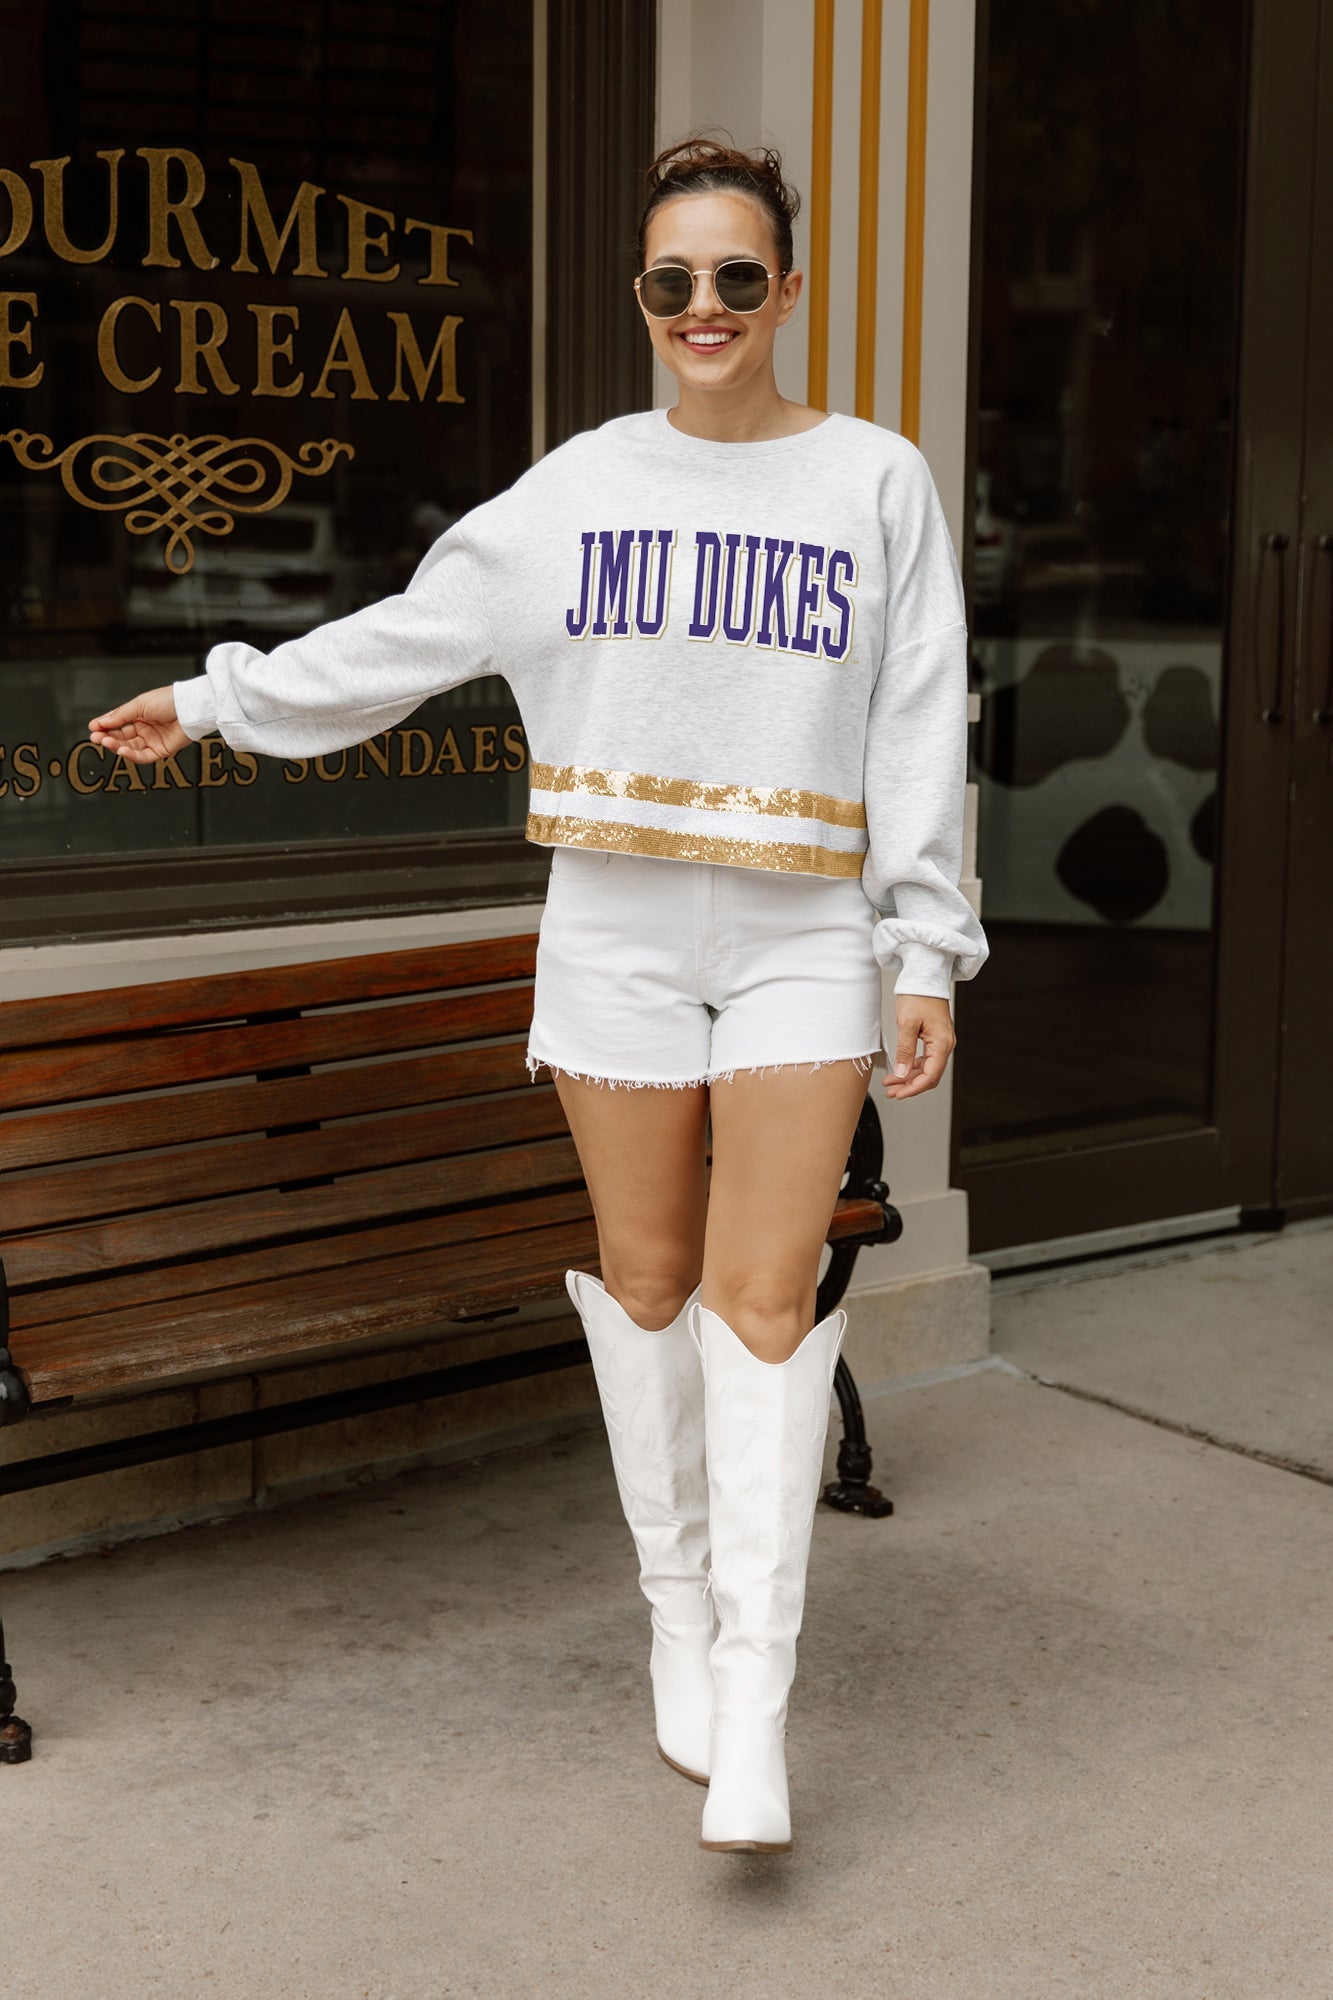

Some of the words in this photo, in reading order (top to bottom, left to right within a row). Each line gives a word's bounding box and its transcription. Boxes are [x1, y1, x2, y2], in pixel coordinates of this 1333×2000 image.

[97, 295, 465, 404] CREAM
[565, 529, 676, 639] JMU
[688, 531, 858, 662] DUKES
